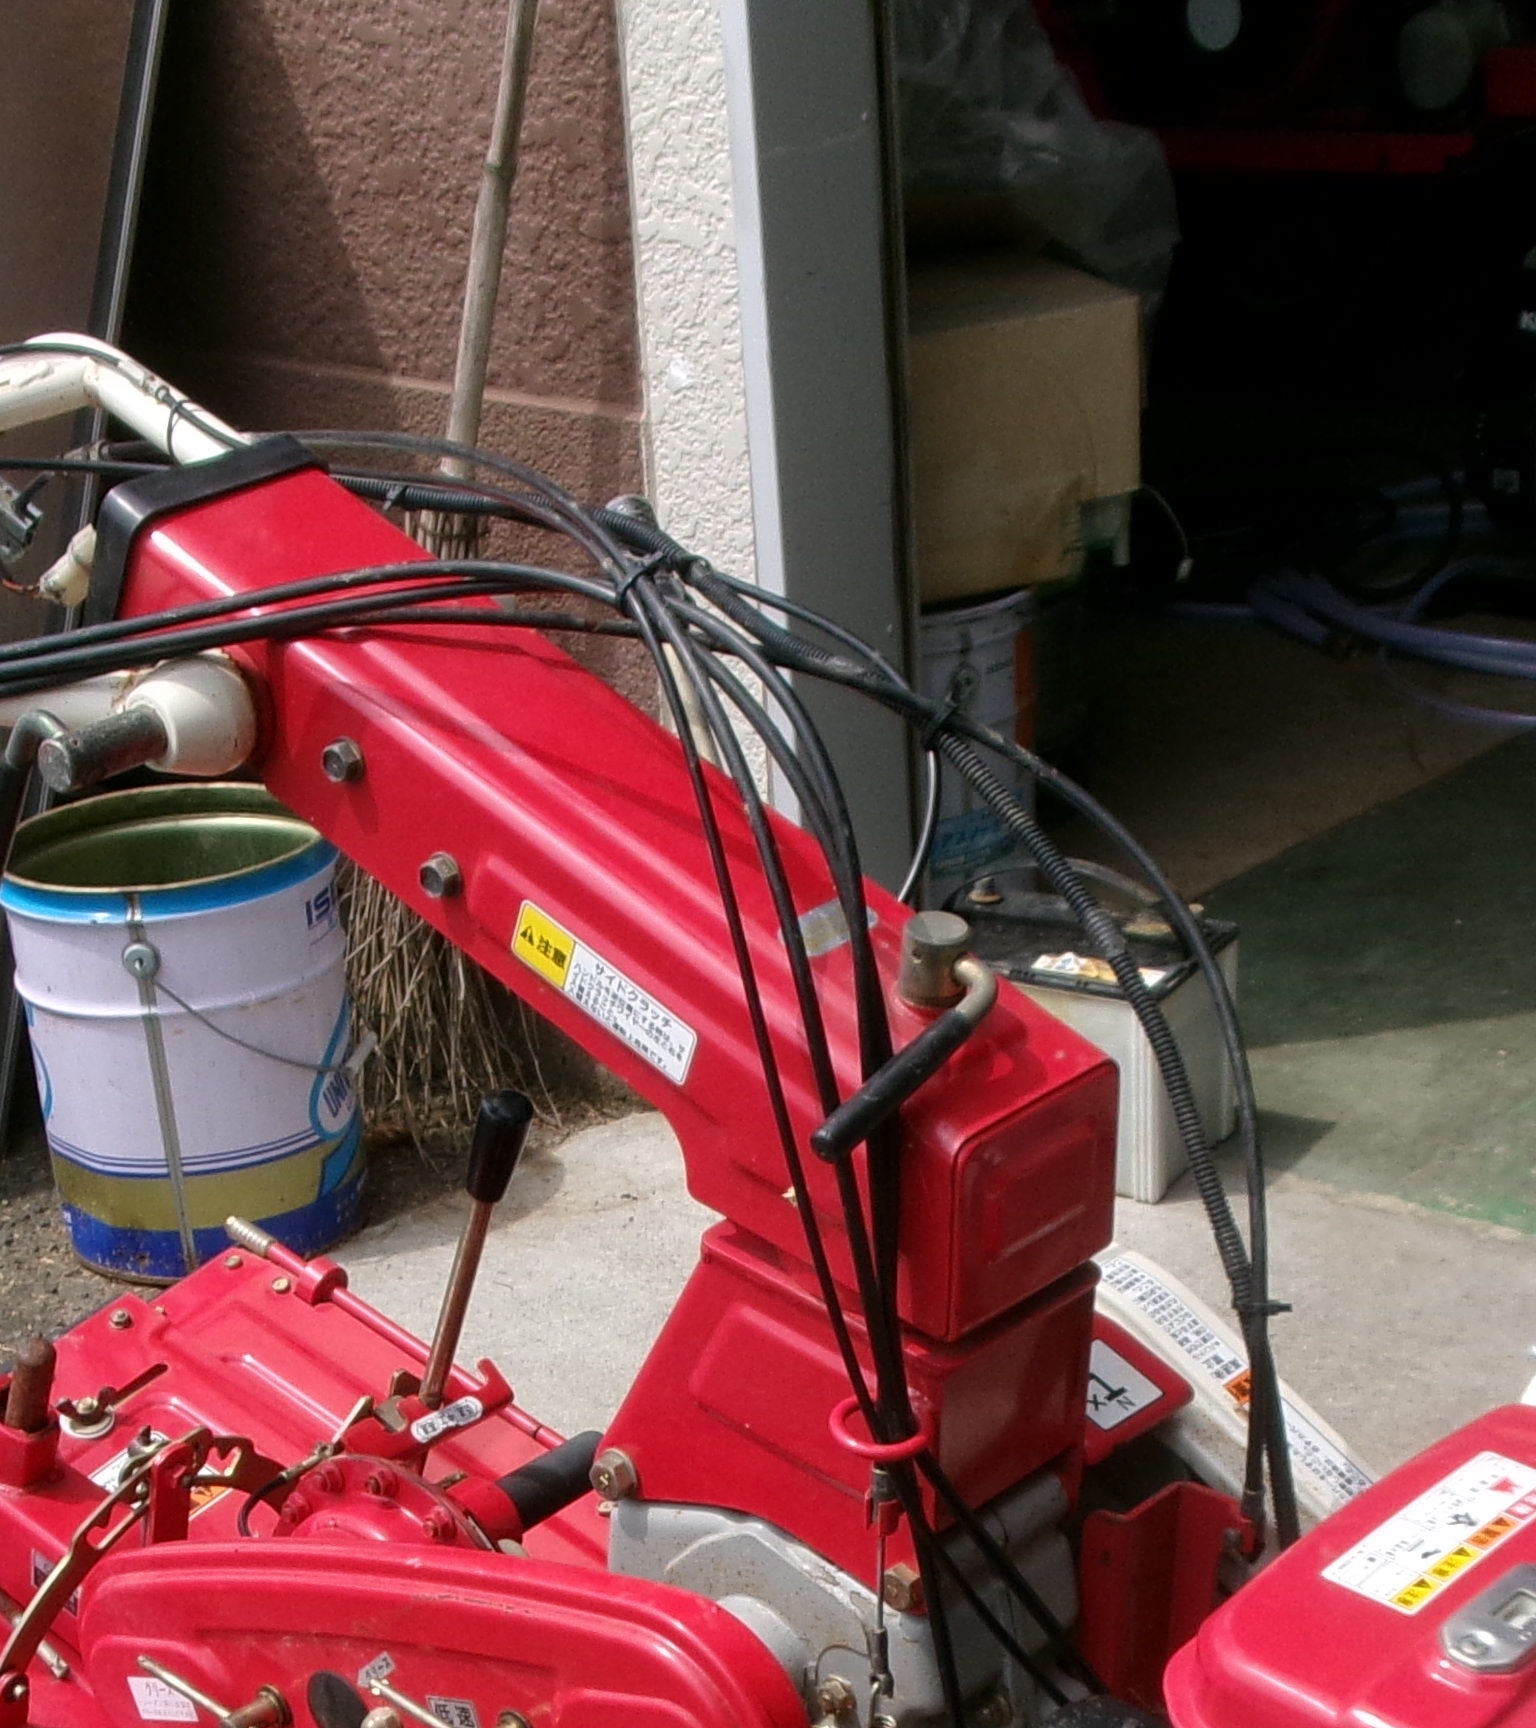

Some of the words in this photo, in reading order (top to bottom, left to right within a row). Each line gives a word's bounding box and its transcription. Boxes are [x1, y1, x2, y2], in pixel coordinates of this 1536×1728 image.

[305, 885, 336, 928] IS
[535, 936, 567, 969] 注意
[594, 963, 673, 1029] サイドクラッチ
